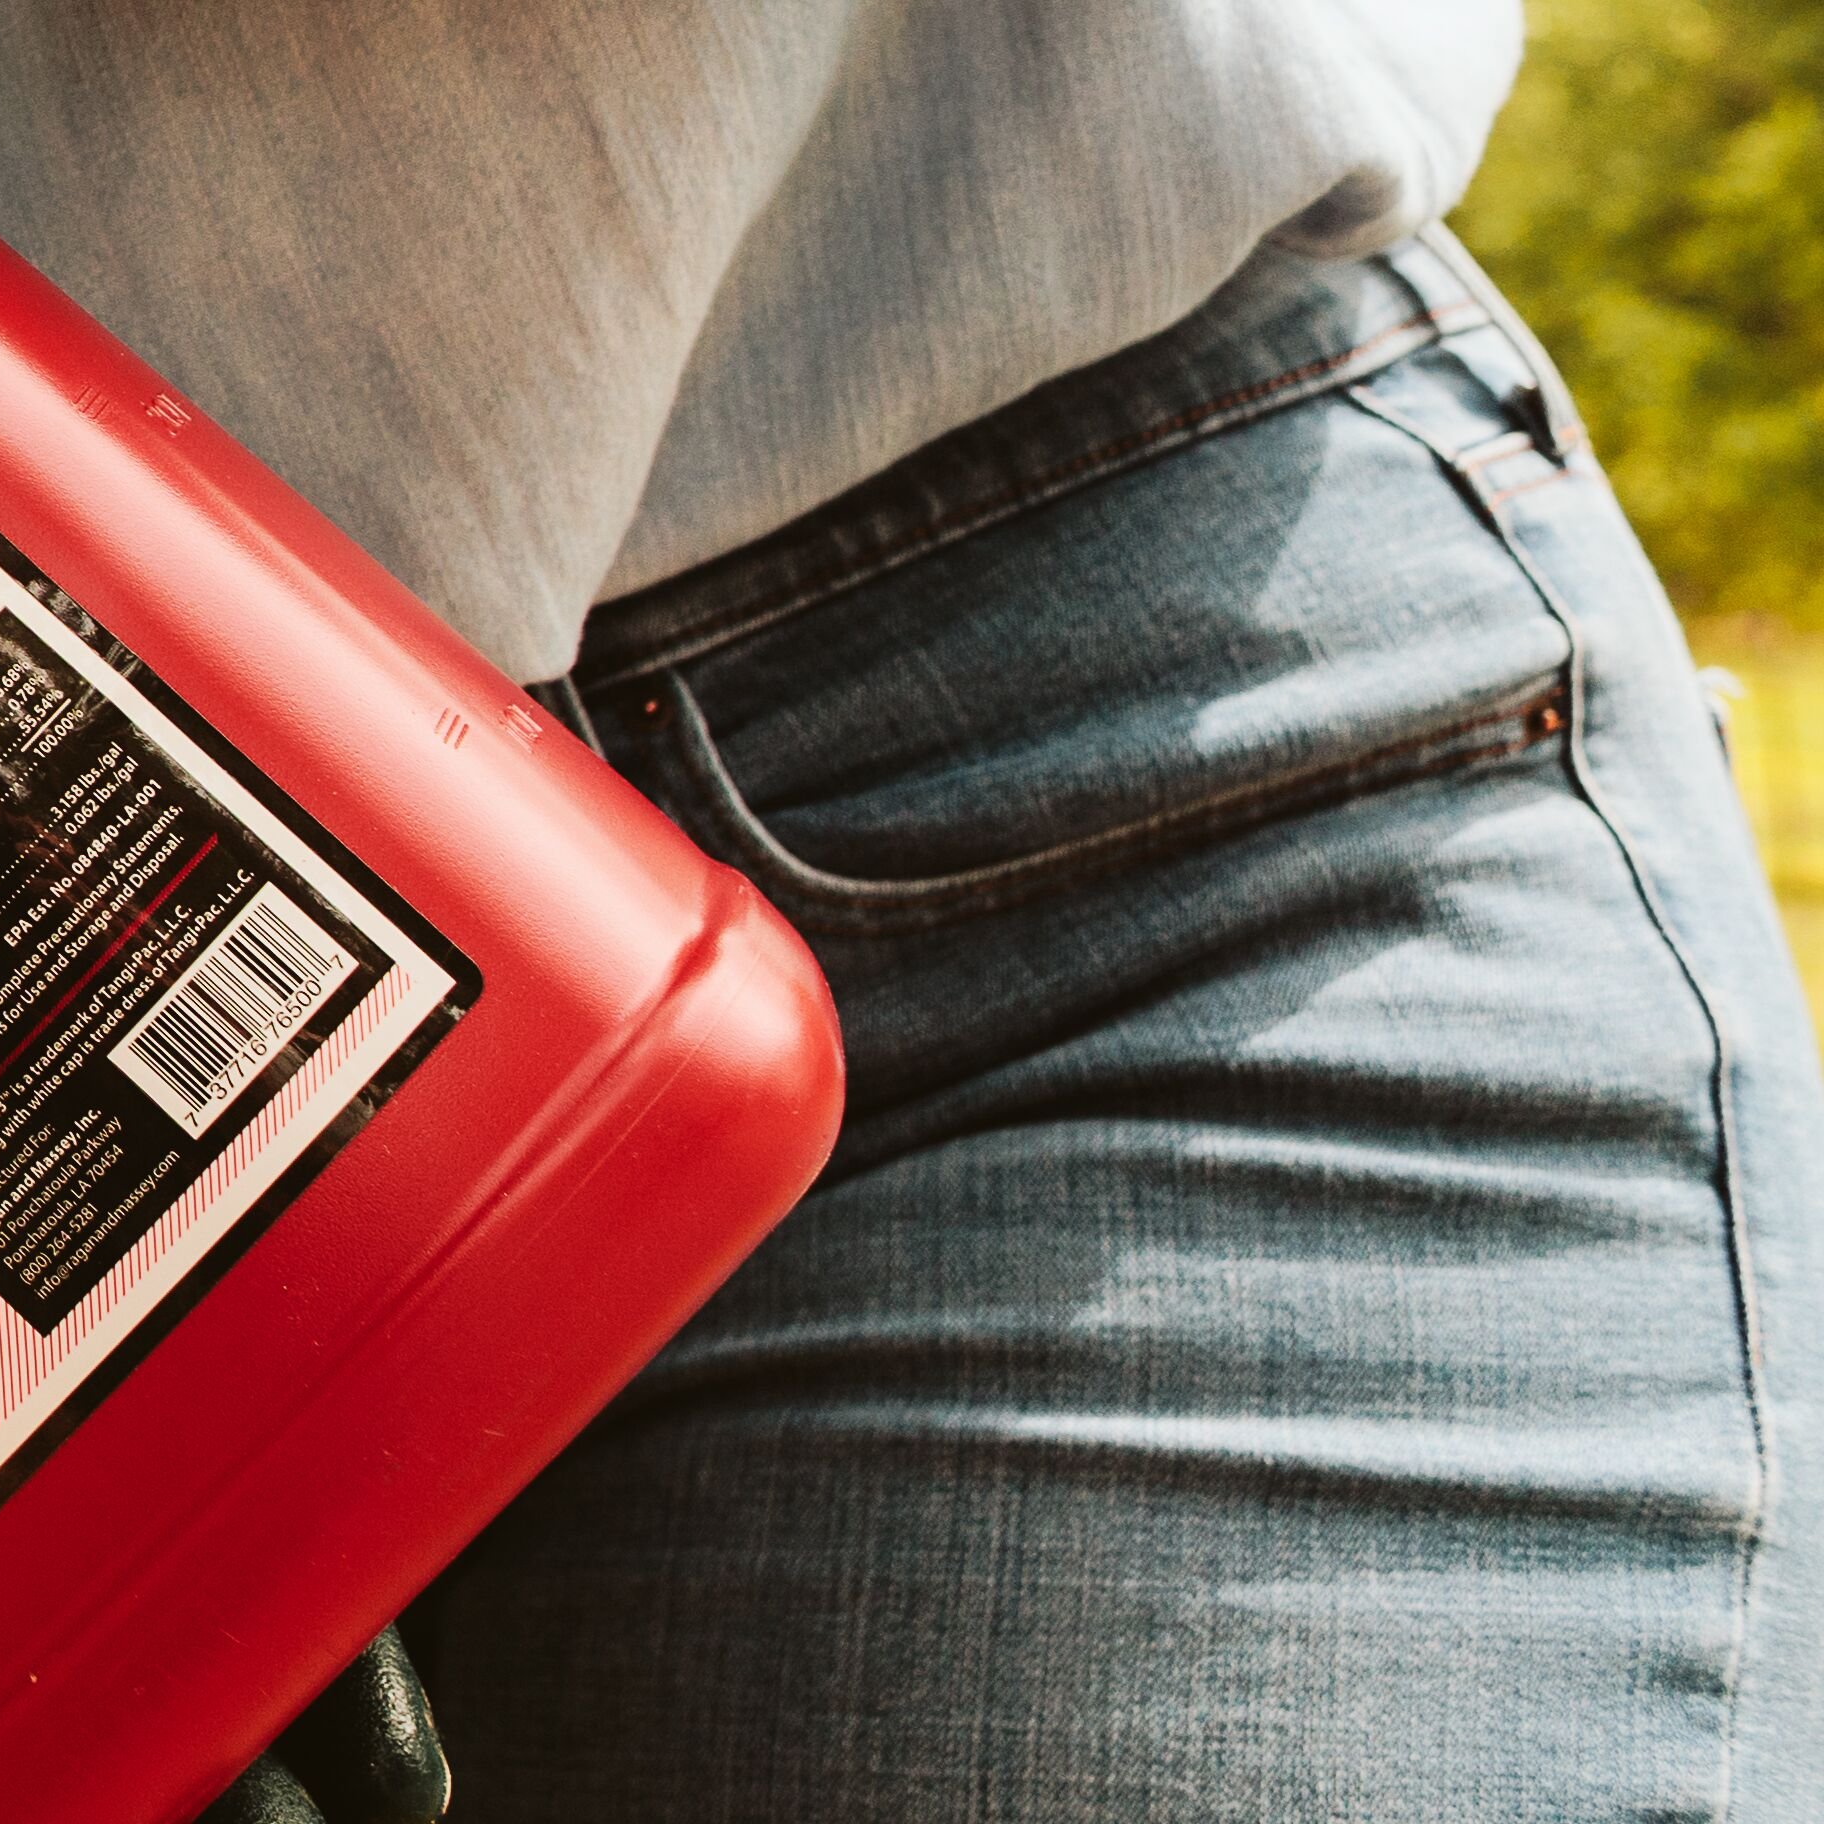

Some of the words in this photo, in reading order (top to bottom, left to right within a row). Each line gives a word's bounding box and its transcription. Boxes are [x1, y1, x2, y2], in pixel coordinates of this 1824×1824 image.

[2, 918, 33, 947] EPA
[26, 897, 56, 922] Est.
[48, 875, 77, 898] No.
[70, 778, 162, 875] 084840-LA-001
[35, 870, 119, 956] Precautionary
[111, 804, 184, 875] Statements,
[203, 1038, 267, 1100] 37716
[263, 978, 322, 1039] 76500
[5, 1163, 77, 1234] Ponchatoula
[70, 1115, 122, 1167] Parkway
[9, 1171, 36, 1202] and
[28, 1130, 81, 1179] Massey,
[72, 1108, 102, 1132] Inc.
[27, 1122, 56, 1149] For:
[2, 1198, 78, 1270] Ponchatoula,
[69, 1179, 92, 1199] LA
[85, 1143, 124, 1182] 70454
[18, 1251, 52, 1286] (800)
[45, 1201, 99, 1257] 264-5281
[35, 1149, 181, 1300] info@raganandmassey.com
